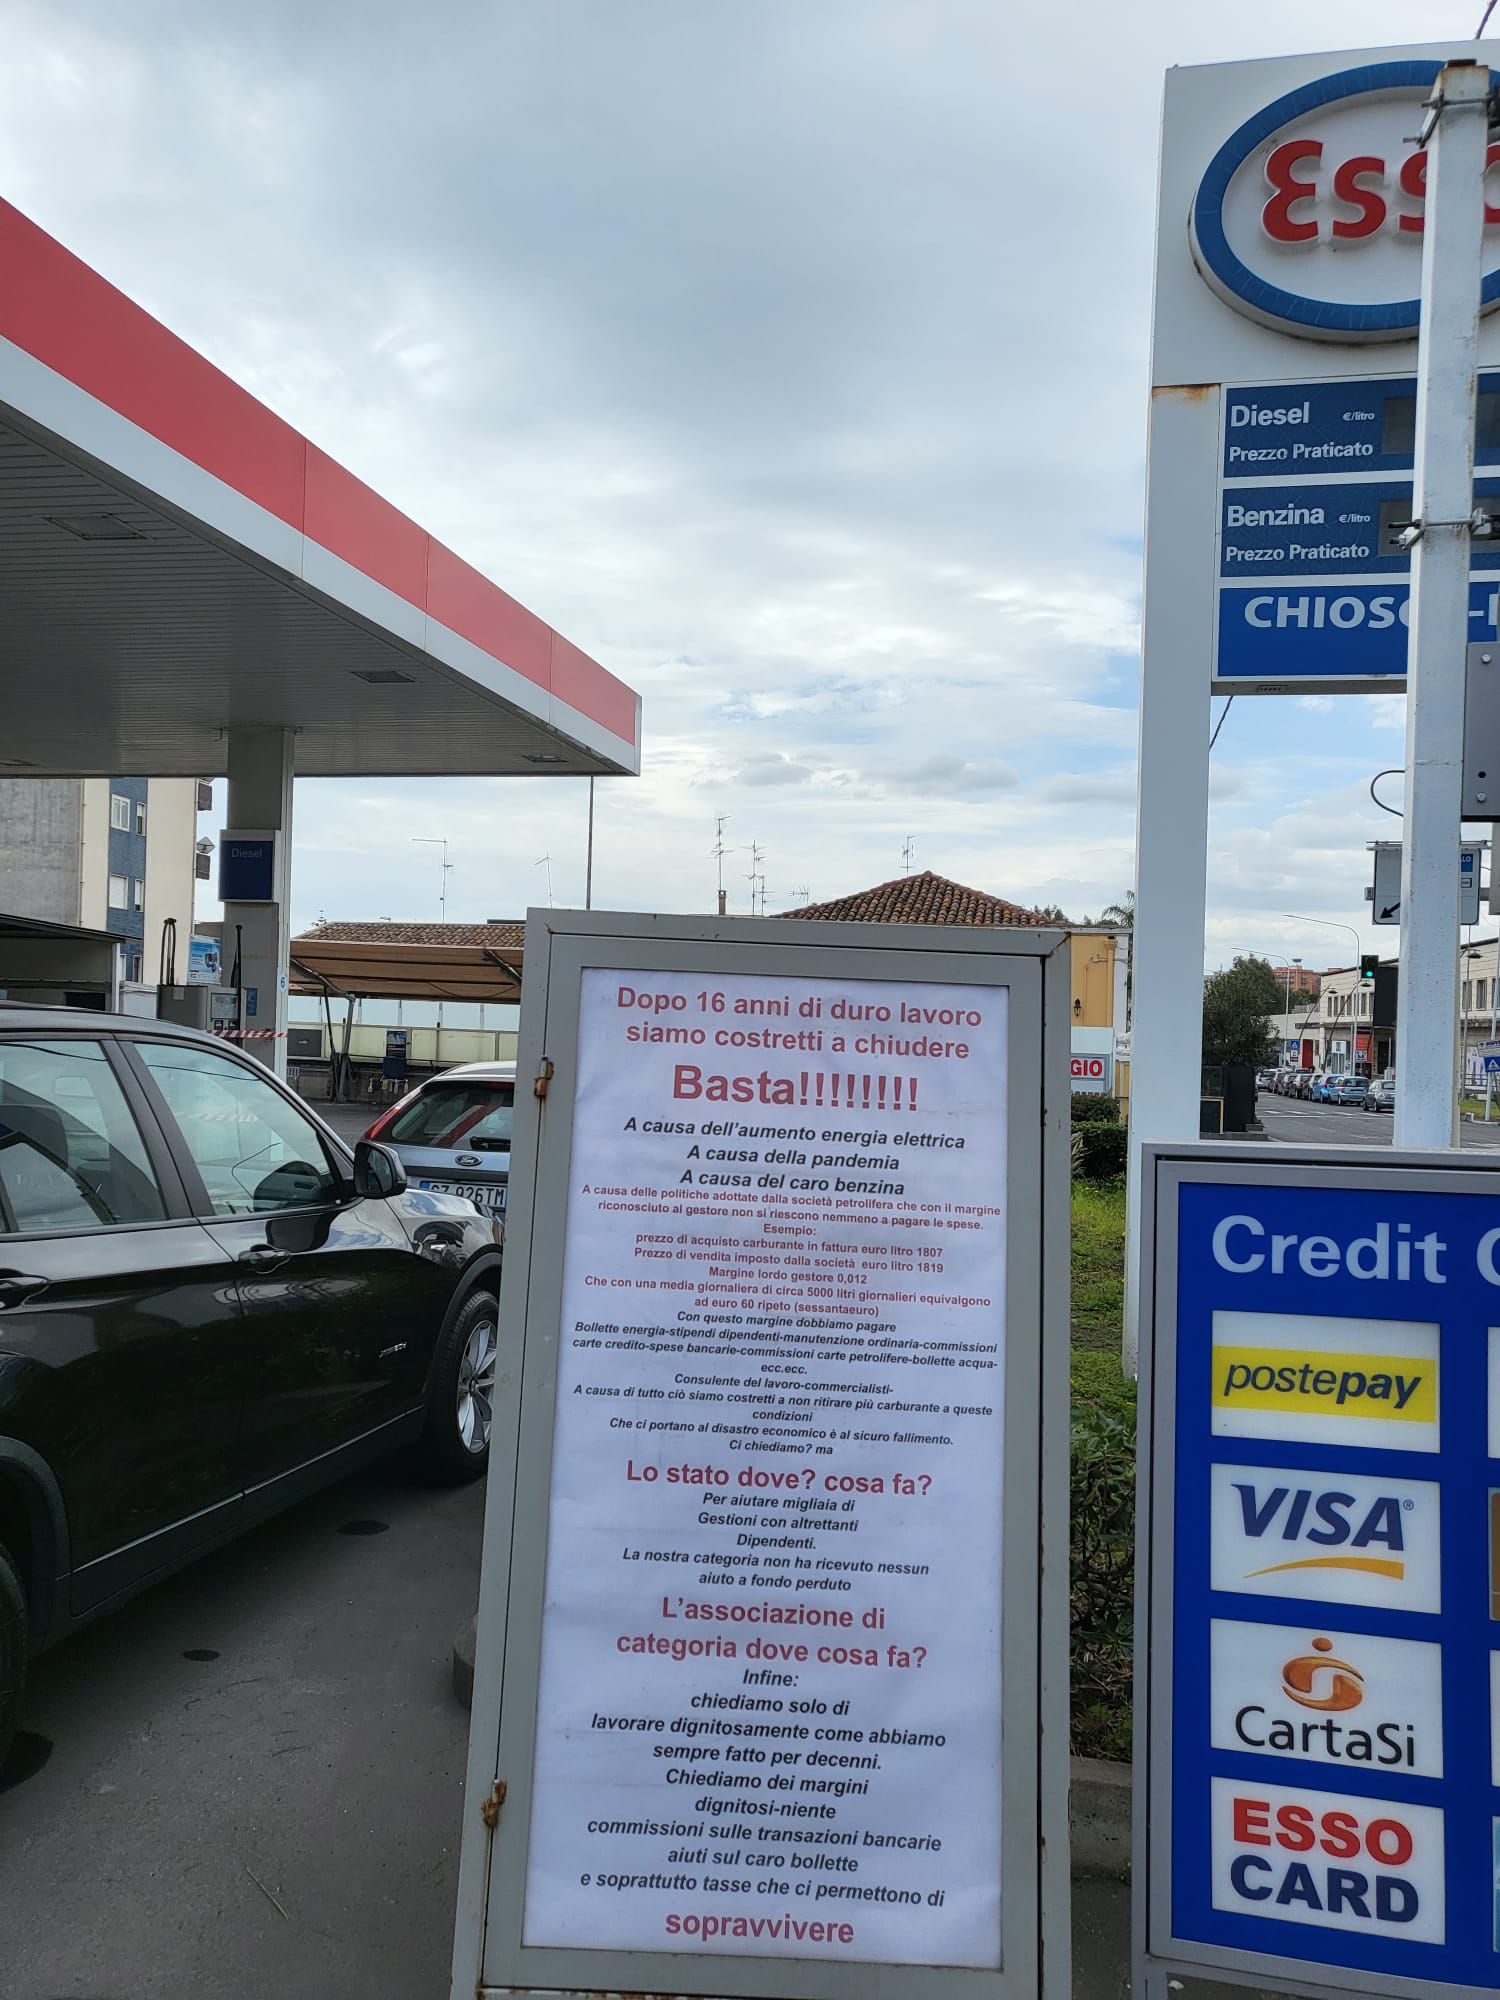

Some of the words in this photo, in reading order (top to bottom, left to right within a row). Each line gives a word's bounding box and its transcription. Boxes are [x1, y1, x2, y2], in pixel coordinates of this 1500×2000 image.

[1262, 139, 1500, 242] Es
[1230, 401, 1310, 427] Diesel
[1342, 411, 1375, 422] €/litro
[1229, 446, 1288, 462] Prezzo
[1292, 441, 1374, 460] Praticato
[1227, 503, 1325, 527] Benzina
[1338, 513, 1371, 523] €/litro
[1225, 546, 1285, 562] Prezzo
[1289, 543, 1370, 561] Praticato
[231, 847, 262, 858] Diesel
[617, 987, 687, 1015] Dopo
[697, 991, 725, 1013] 16
[734, 996, 789, 1016] anni
[798, 997, 822, 1018] di
[830, 999, 891, 1022] duro
[900, 1002, 982, 1027] lavoro
[626, 1021, 706, 1044] siamo
[715, 1028, 823, 1051] costretti
[831, 1036, 845, 1052] a
[855, 1033, 969, 1059] chiudere
[623, 1117, 637, 1132] A
[642, 1121, 695, 1134] causa
[821, 1129, 888, 1147] energia
[893, 1131, 965, 1149] elettrica
[686, 1144, 700, 1160] A
[706, 1149, 759, 1162] causa
[764, 1148, 807, 1165] della
[811, 1153, 899, 1170] pandemia
[679, 1169, 693, 1184] A
[698, 1173, 752, 1187] causa
[757, 1173, 786, 1189] del
[789, 1178, 829, 1191] caro
[834, 1176, 905, 1195] benzina
[582, 1184, 591, 1194] A
[594, 1187, 627, 1196] causa
[631, 1187, 658, 1197] delle
[661, 1189, 709, 1200] politiche
[712, 1191, 758, 1202] adottate
[761, 1193, 788, 1204] dalla
[791, 1196, 832, 1206] società
[835, 1198, 893, 1210] petrolifera
[897, 1201, 917, 1211] che
[920, 1204, 941, 1212] con
[945, 1203, 951, 1213] il
[955, 1205, 1000, 1217] margine
[763, 1223, 816, 1237] Esempio:
[1212, 1214, 1448, 1284] Credit
[694, 1296, 709, 1307] ad
[712, 1299, 738, 1308] euro
[741, 1298, 754, 1309] 60
[758, 1300, 791, 1312] ripeto
[794, 1301, 879, 1318] (sessantaeuro)
[677, 1311, 700, 1322] Con
[703, 1314, 743, 1325] questo
[746, 1315, 793, 1328] margine
[795, 1316, 853, 1330] dobbiamo
[856, 1322, 896, 1334] pagare
[674, 1373, 741, 1387] Consulente
[743, 1377, 762, 1388] del
[1224, 1363, 1422, 1409] postepay
[752, 1410, 814, 1422] condizioni
[610, 1417, 633, 1429] Che
[636, 1419, 647, 1429] ci
[648, 1421, 695, 1432] portano
[697, 1422, 709, 1432] al
[711, 1423, 759, 1435] disastro
[762, 1427, 827, 1439] economico
[829, 1428, 837, 1439] è
[839, 1429, 851, 1440] al
[853, 1430, 890, 1442] sicuro
[893, 1432, 953, 1445] fallimento.
[729, 1439, 742, 1450] Ci
[744, 1440, 813, 1454] chiediamo?
[815, 1446, 833, 1455] ma
[627, 1460, 658, 1482] Lo
[666, 1463, 730, 1486] stato
[738, 1465, 816, 1490] dove?
[824, 1475, 884, 1494] cosa
[892, 1473, 932, 1496] fa?
[702, 1492, 728, 1505] Per
[730, 1494, 779, 1508] aiutare
[782, 1497, 838, 1513] migliaia
[841, 1499, 856, 1512] di
[698, 1511, 758, 1527] Gestioni
[760, 1517, 787, 1528] con
[790, 1516, 859, 1532] altrettanti
[1231, 1484, 1404, 1551] VISA
[736, 1533, 816, 1549] Dipendenti.
[622, 1547, 640, 1560] La
[644, 1550, 690, 1563] nostra
[693, 1552, 759, 1568] categoria
[763, 1557, 791, 1568] non
[794, 1556, 812, 1569] ha
[815, 1557, 873, 1572] ricevuto
[877, 1563, 929, 1575] nessun
[699, 1571, 735, 1585] aiuto
[738, 1576, 747, 1586] a
[751, 1573, 792, 1588] fondo
[795, 1577, 851, 1591] perduto
[862, 1607, 885, 1630] di
[617, 1632, 737, 1661] categoria
[746, 1637, 809, 1662] dove
[817, 1646, 878, 1666] cosa
[886, 1645, 927, 1668] fa?
[742, 1668, 799, 1687] Infine:
[691, 1692, 783, 1712] chiediamo
[788, 1698, 827, 1715] solo
[832, 1700, 851, 1716] di
[591, 1713, 665, 1732] lavorare
[670, 1717, 809, 1740] dignitosamente
[814, 1728, 864, 1743] come
[868, 1728, 946, 1747] abbiamo
[1235, 1705, 1416, 1767] CartaSi
[652, 1745, 720, 1763] sempre
[725, 1745, 766, 1763] fatto
[770, 1752, 802, 1767] per
[806, 1750, 881, 1770] decenni.
[666, 1768, 762, 1789] Chiediamo
[767, 1773, 796, 1791] dei
[799, 1778, 869, 1798] margini
[587, 1819, 705, 1837] commissioni
[708, 1823, 752, 1840] sulle
[758, 1826, 859, 1846] transazioni
[862, 1830, 942, 1852] bancarie
[1233, 1797, 1414, 1866] ESSO
[667, 1847, 709, 1864] aiuti
[712, 1849, 741, 1865] sul
[745, 1854, 785, 1868] caro
[790, 1852, 859, 1872] bollette
[580, 1873, 591, 1886] e
[596, 1873, 697, 1891] soprattutto
[703, 1875, 752, 1893] tasse
[757, 1877, 790, 1895] che
[795, 1880, 812, 1896] ci
[815, 1884, 922, 1905] permettono
[927, 1889, 945, 1907] di
[1230, 1854, 1419, 1923] CARD
[665, 1913, 854, 1944] sopravvivere
